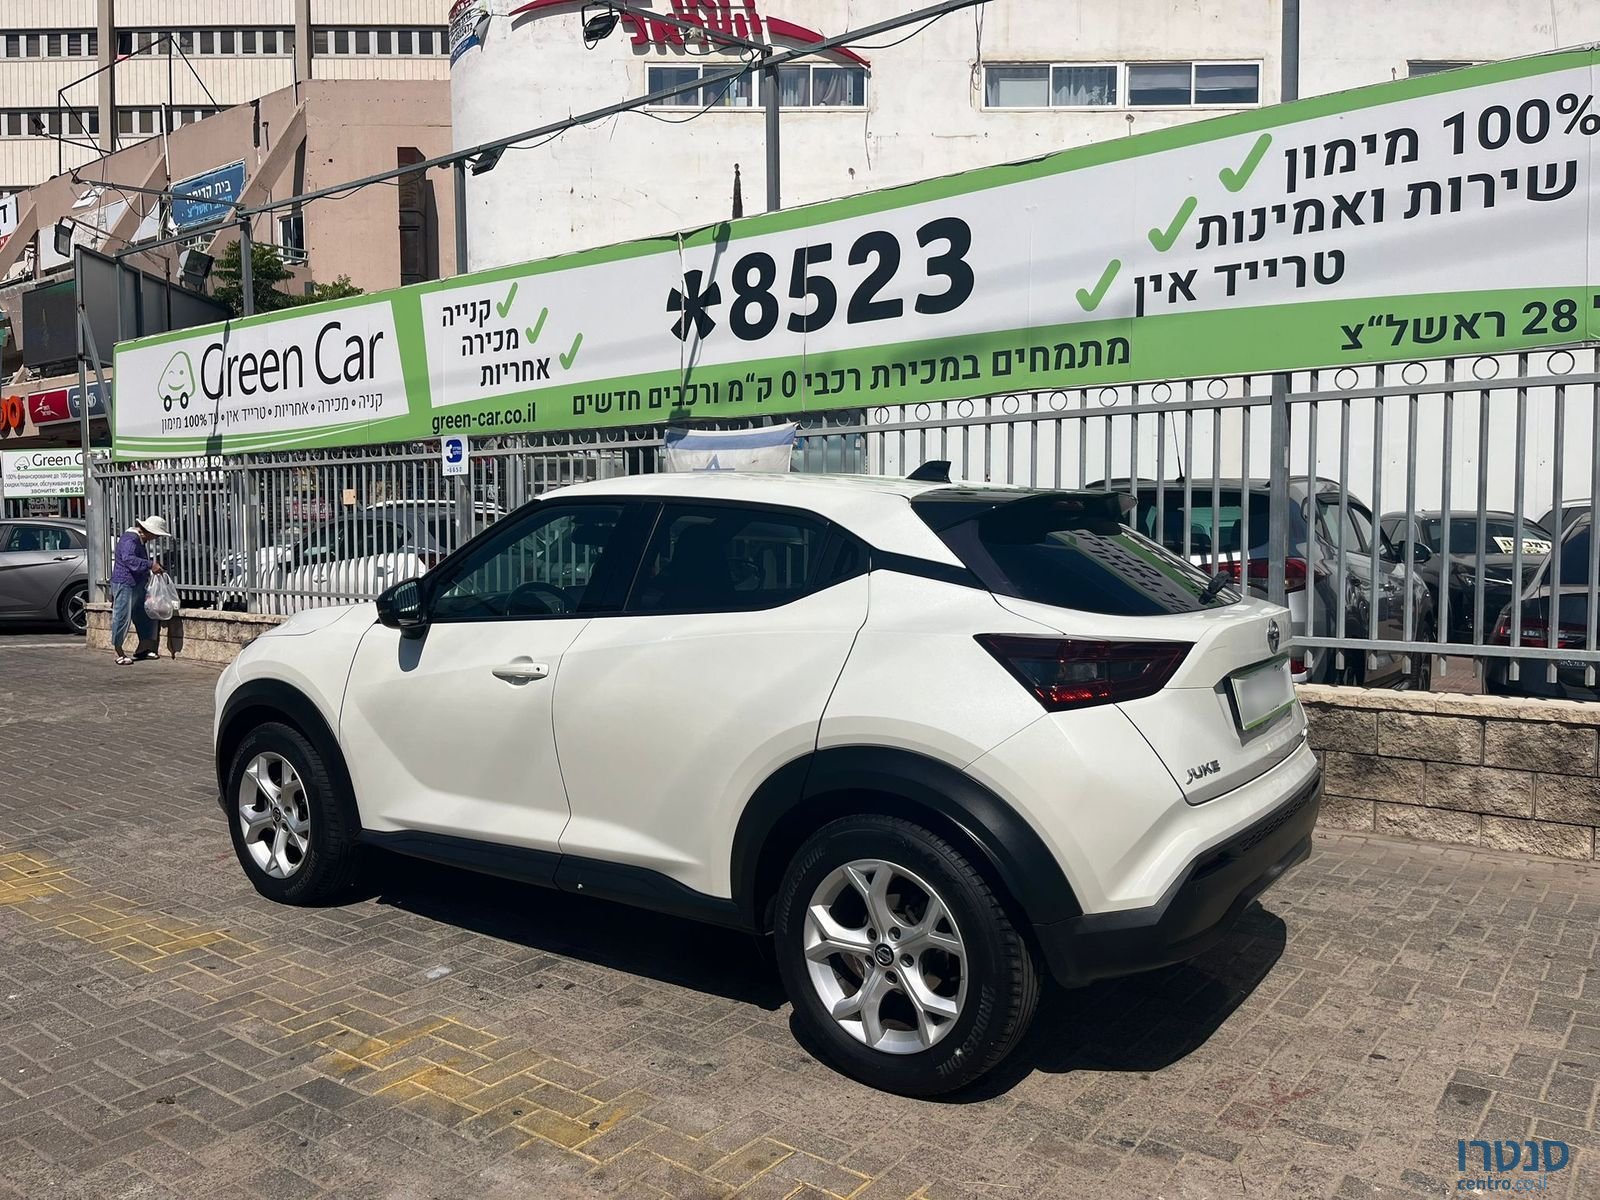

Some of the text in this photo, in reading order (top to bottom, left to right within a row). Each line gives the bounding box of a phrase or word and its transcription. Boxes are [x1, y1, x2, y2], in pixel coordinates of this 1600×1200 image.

[1284, 93, 1600, 194] 100% מימון
[215, 180, 231, 195] בית
[1195, 160, 1577, 250] שירות ואמינות
[1134, 250, 1345, 317] טרייד אין
[442, 299, 491, 328] קנייה
[1521, 298, 1577, 335] 28
[462, 327, 519, 357] מכירה
[201, 321, 384, 400] Green Car
[992, 336, 1130, 377] מתמחים
[480, 357, 551, 387] אחריות
[781, 370, 796, 398] 0
[804, 368, 861, 396] רכבי
[870, 354, 981, 390] במכירת
[274, 401, 309, 418] אחריות
[318, 397, 349, 414] מכירה
[358, 393, 383, 412] קניה
[573, 389, 640, 415] חדשים
[648, 382, 719, 409] ורכבים
[161, 417, 182, 434] מימון
[184, 413, 207, 428] 100%
[226, 409, 239, 427] אין
[241, 406, 266, 421] טרייד
[432, 402, 536, 435] green-car.co.il
[32, 453, 72, 467] Green
[1186, 760, 1221, 785] JUKE
